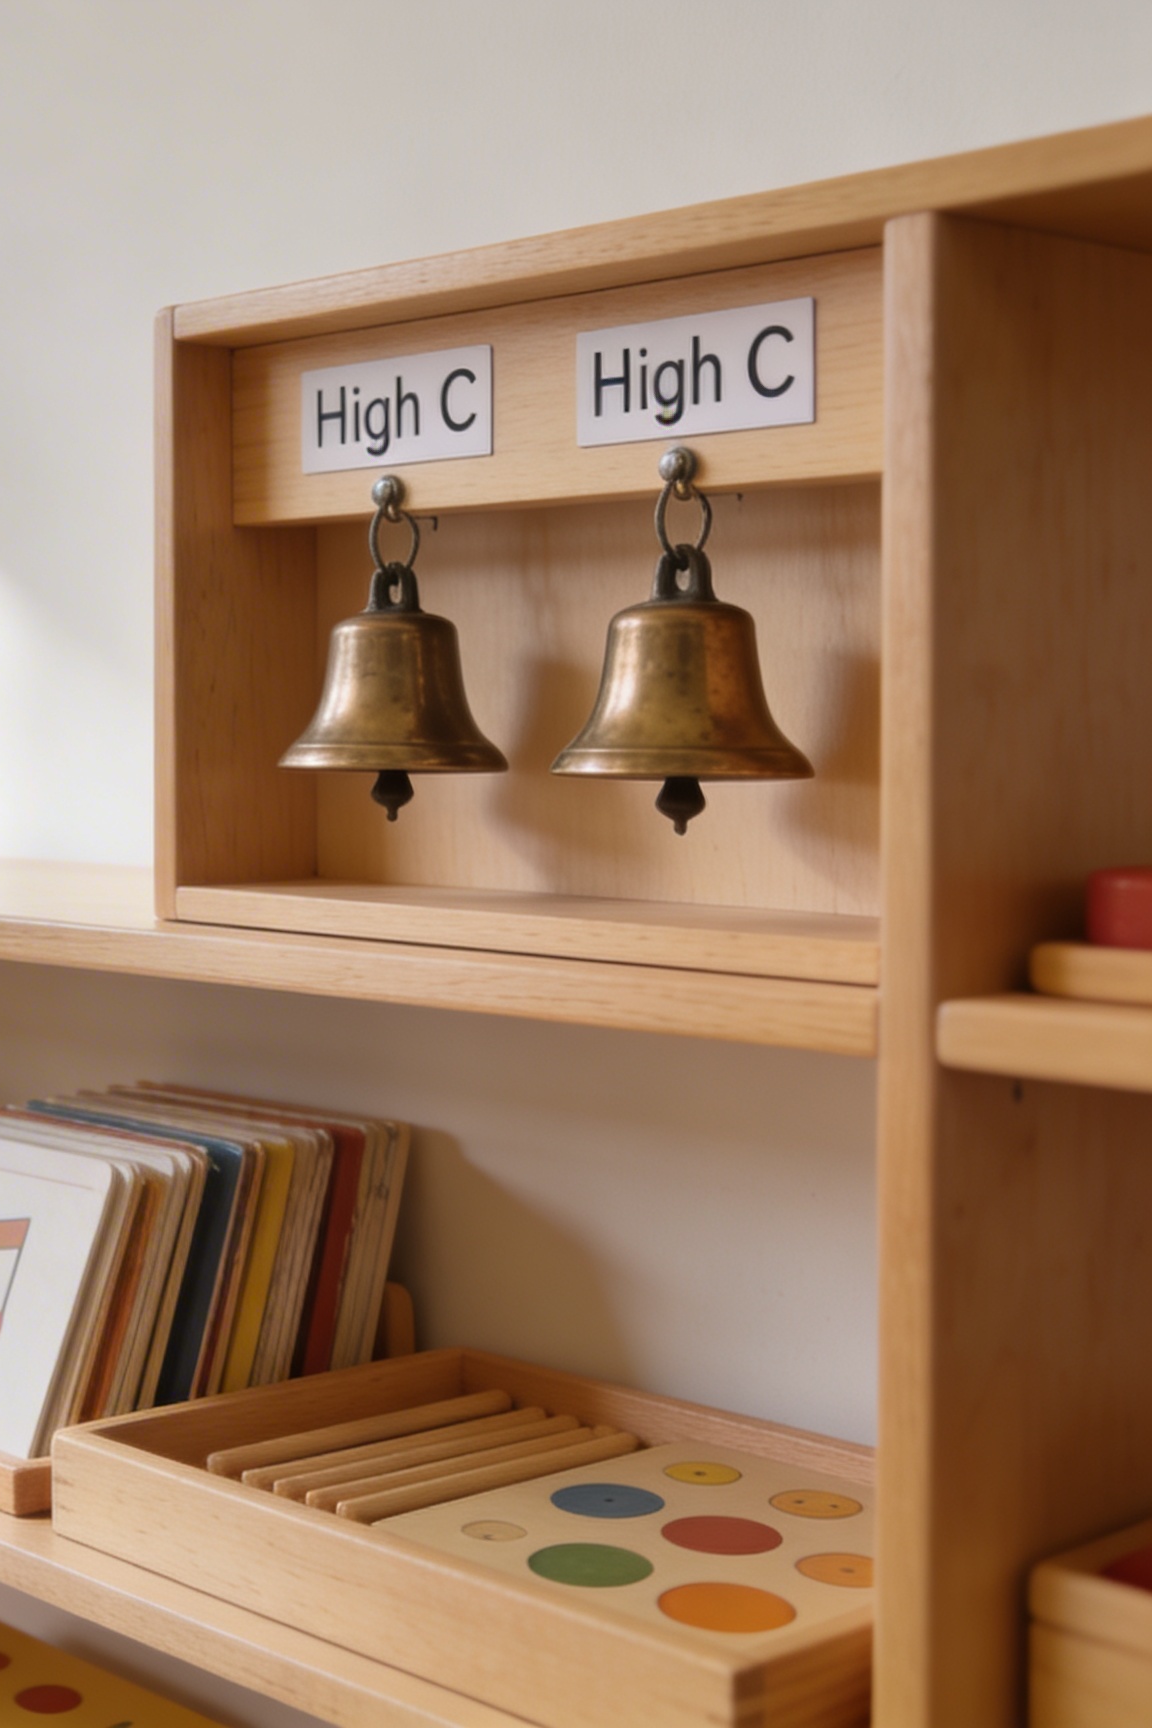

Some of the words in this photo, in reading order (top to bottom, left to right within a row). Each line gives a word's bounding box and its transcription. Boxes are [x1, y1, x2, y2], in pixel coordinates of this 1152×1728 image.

[317, 375, 420, 456] High
[440, 368, 477, 432] C
[594, 335, 722, 426] High
[747, 325, 796, 398] C
